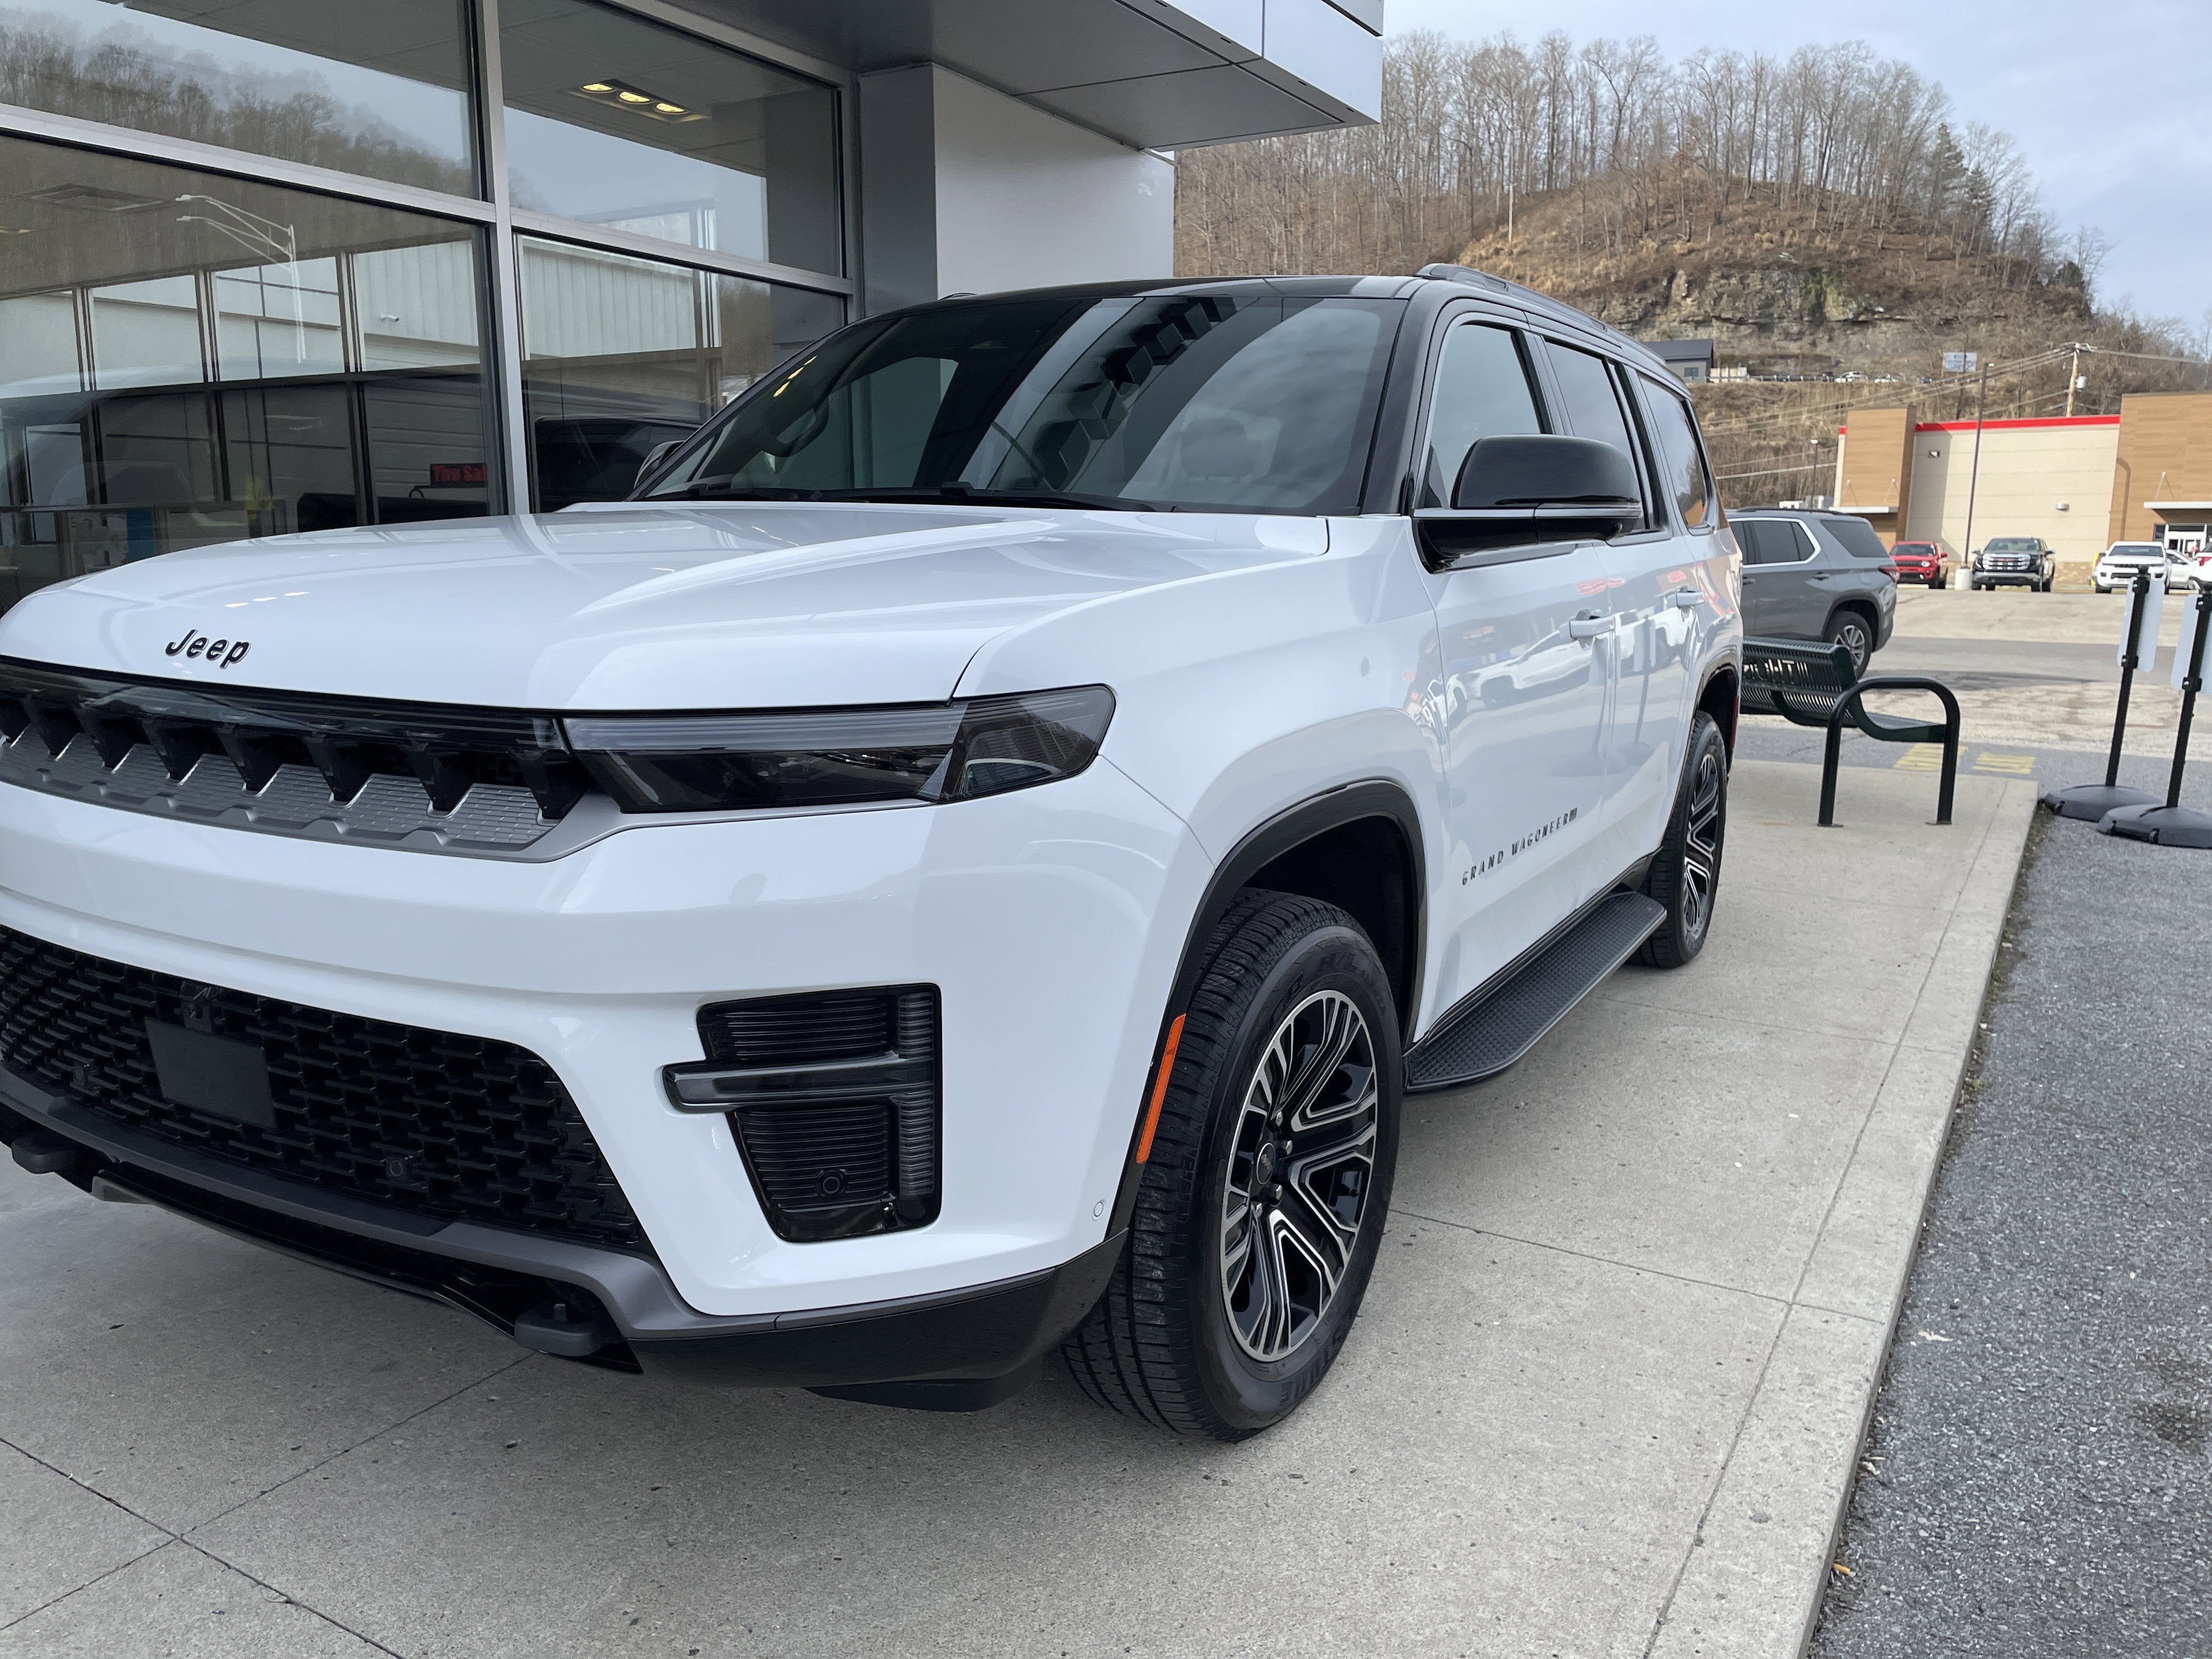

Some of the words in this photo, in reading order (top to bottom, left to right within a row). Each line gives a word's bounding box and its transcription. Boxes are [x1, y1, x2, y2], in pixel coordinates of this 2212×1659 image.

[165, 629, 251, 669] Jeep
[1462, 850, 1504, 886] GRAND
[1511, 812, 1569, 856] WAGONEER
